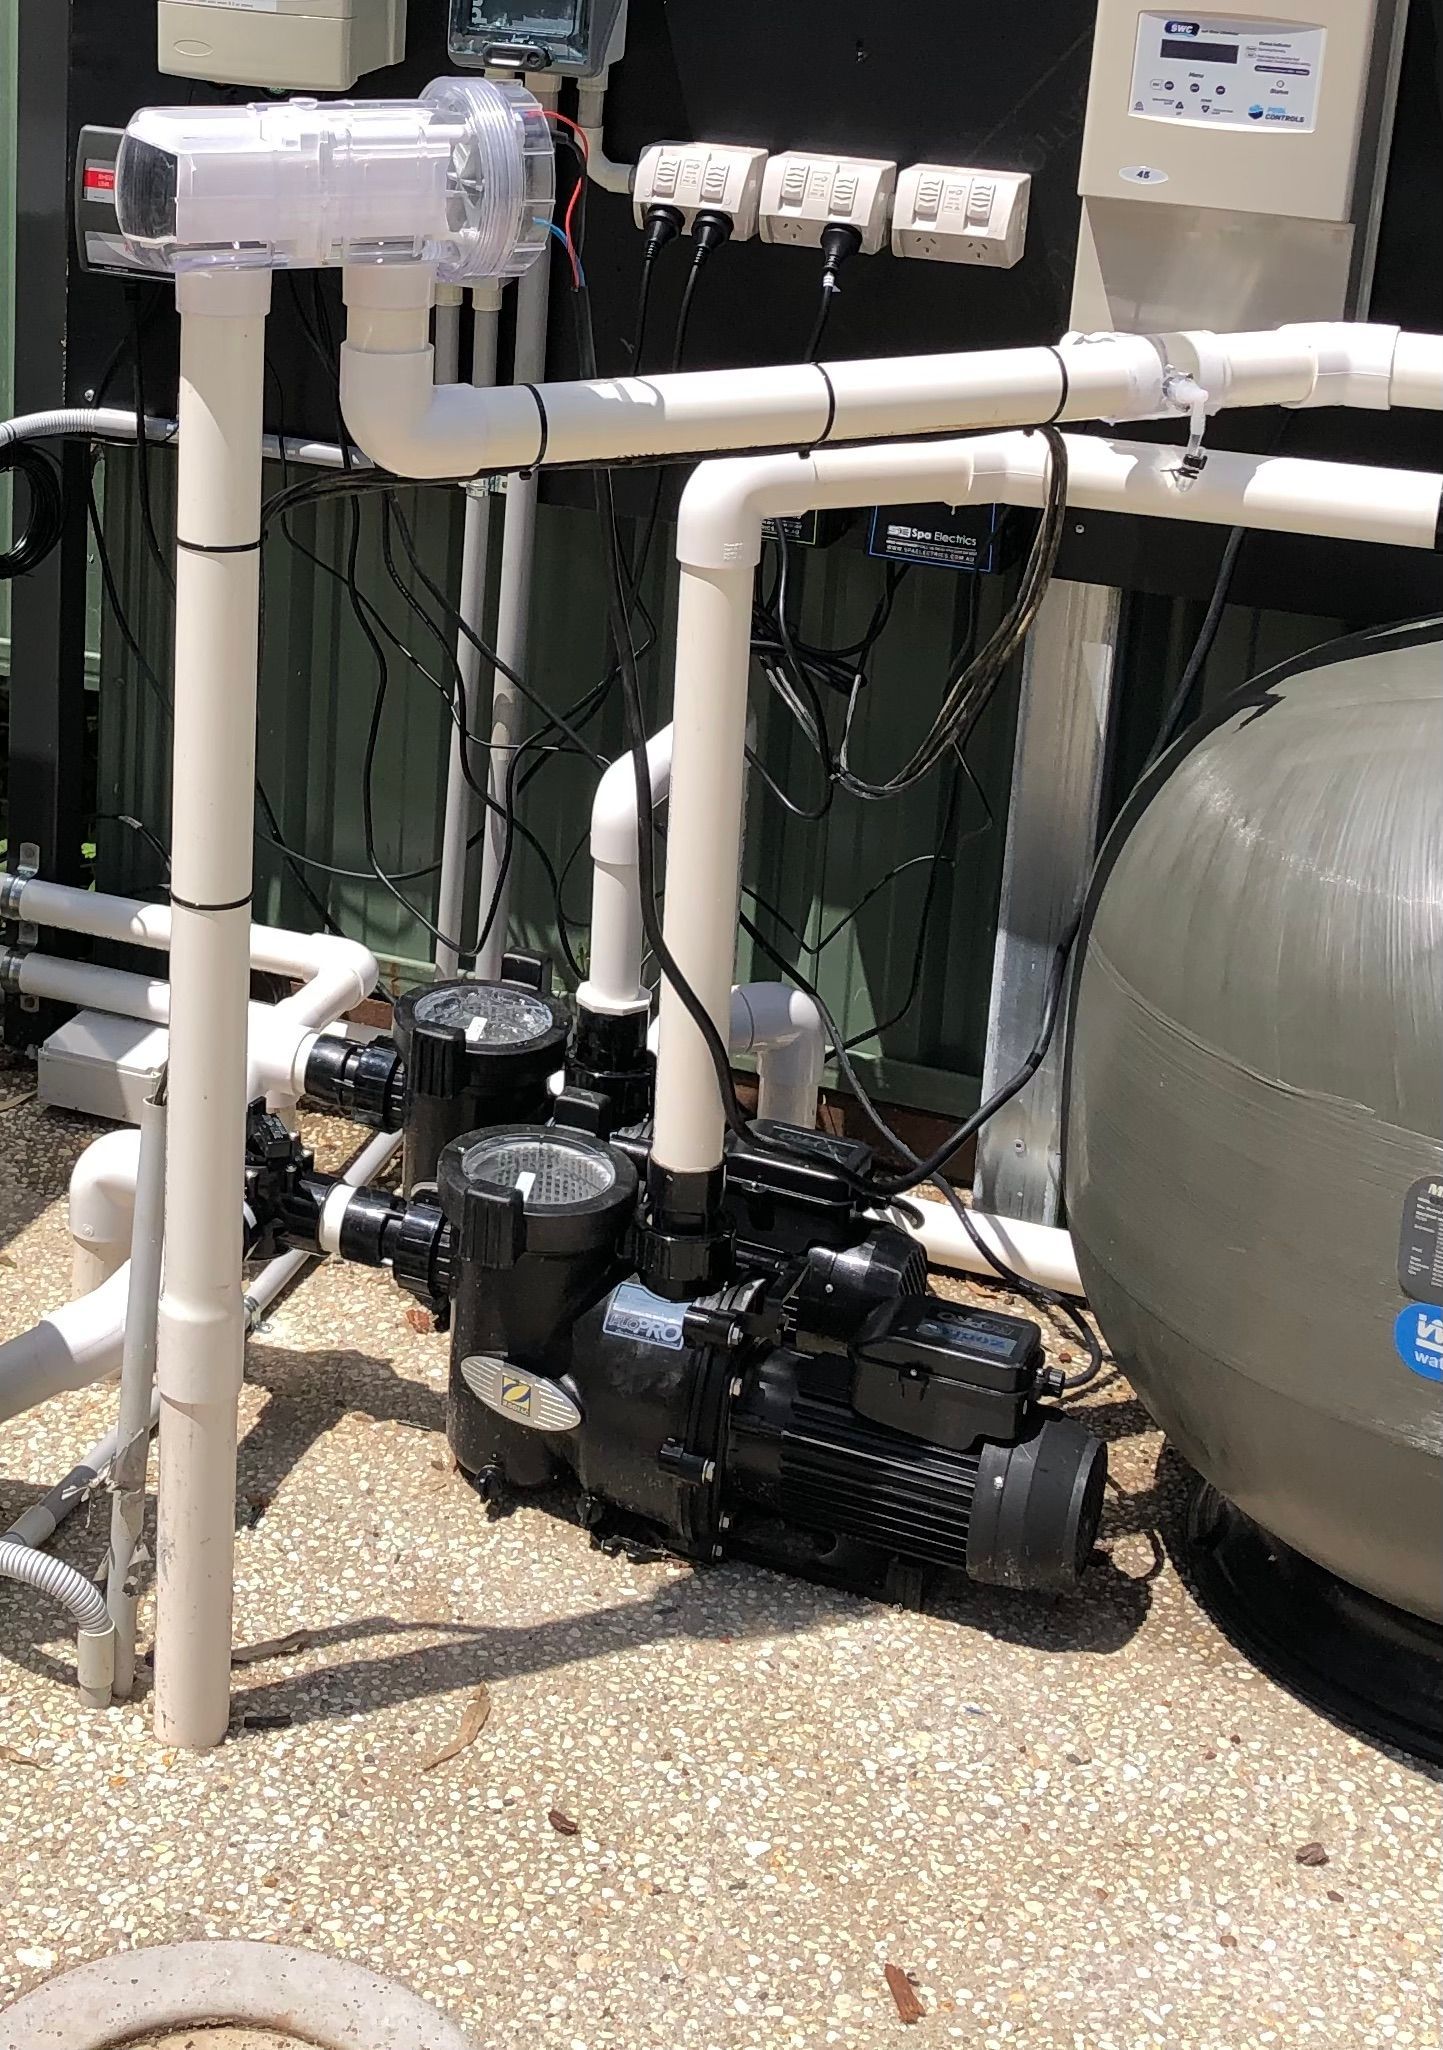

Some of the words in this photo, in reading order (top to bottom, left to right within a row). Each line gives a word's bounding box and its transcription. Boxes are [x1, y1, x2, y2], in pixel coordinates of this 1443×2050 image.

[1170, 24, 1193, 34] SWC
[1265, 113, 1304, 123] CONTROLS
[912, 528, 932, 540] Spa
[934, 531, 977, 546] Electrics
